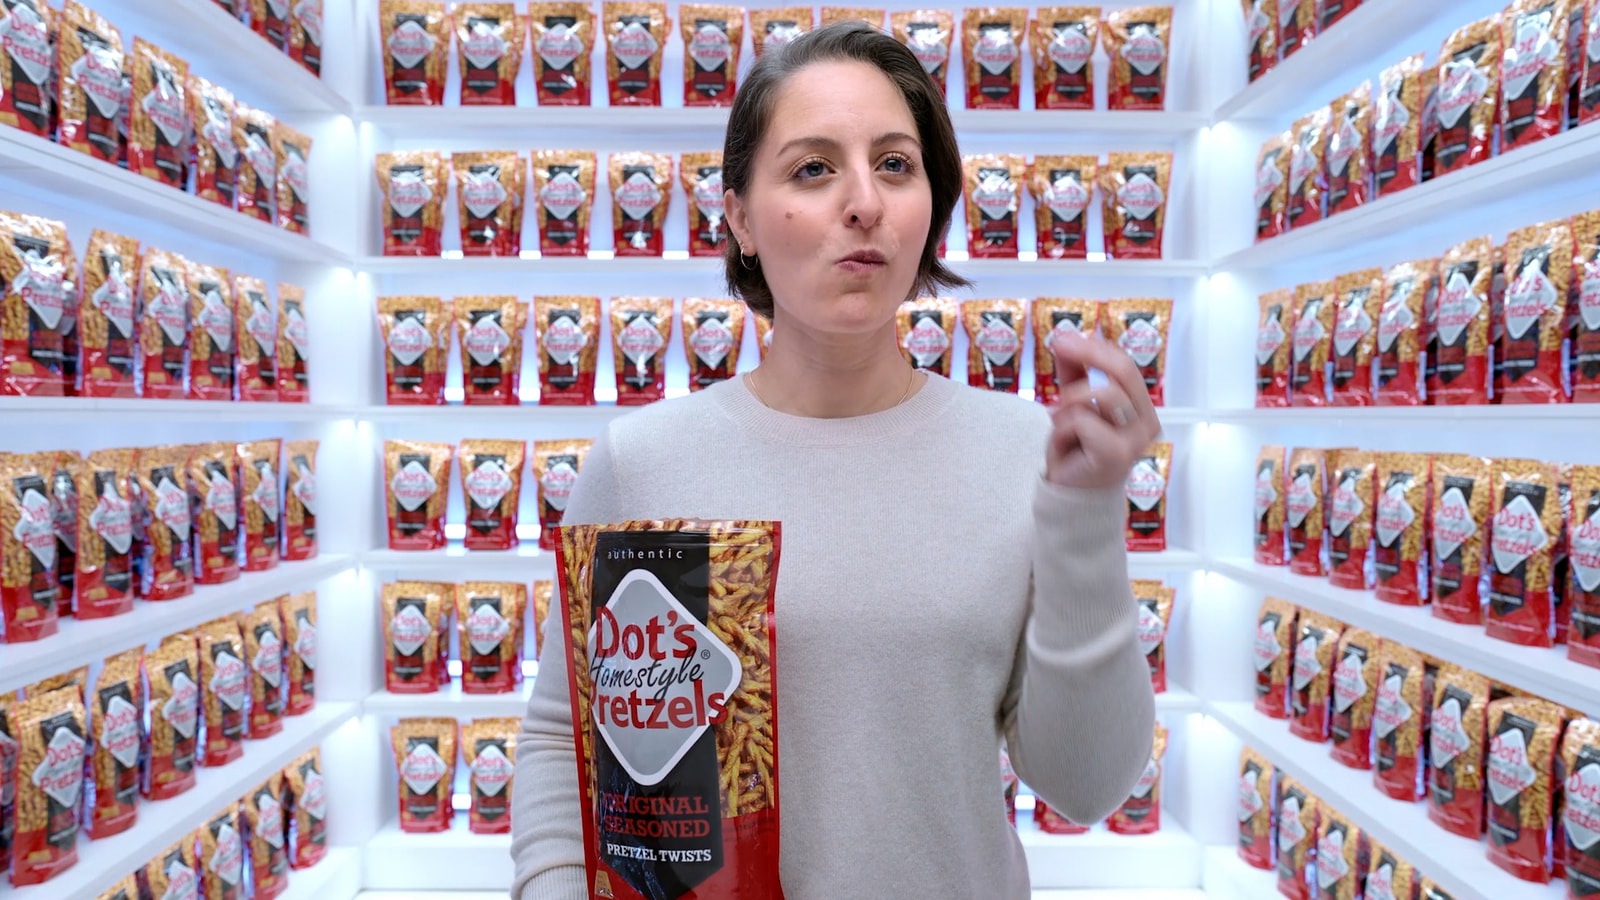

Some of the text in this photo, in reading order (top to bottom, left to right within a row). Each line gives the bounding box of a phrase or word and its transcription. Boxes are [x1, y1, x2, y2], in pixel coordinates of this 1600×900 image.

[607, 547, 683, 560] authentic
[596, 606, 697, 660] Dot's
[590, 646, 704, 703] Homestyle
[602, 792, 709, 815] ORIGINAL
[604, 817, 710, 838] SEASONED
[606, 843, 712, 862] PRETZEL TWISTS
